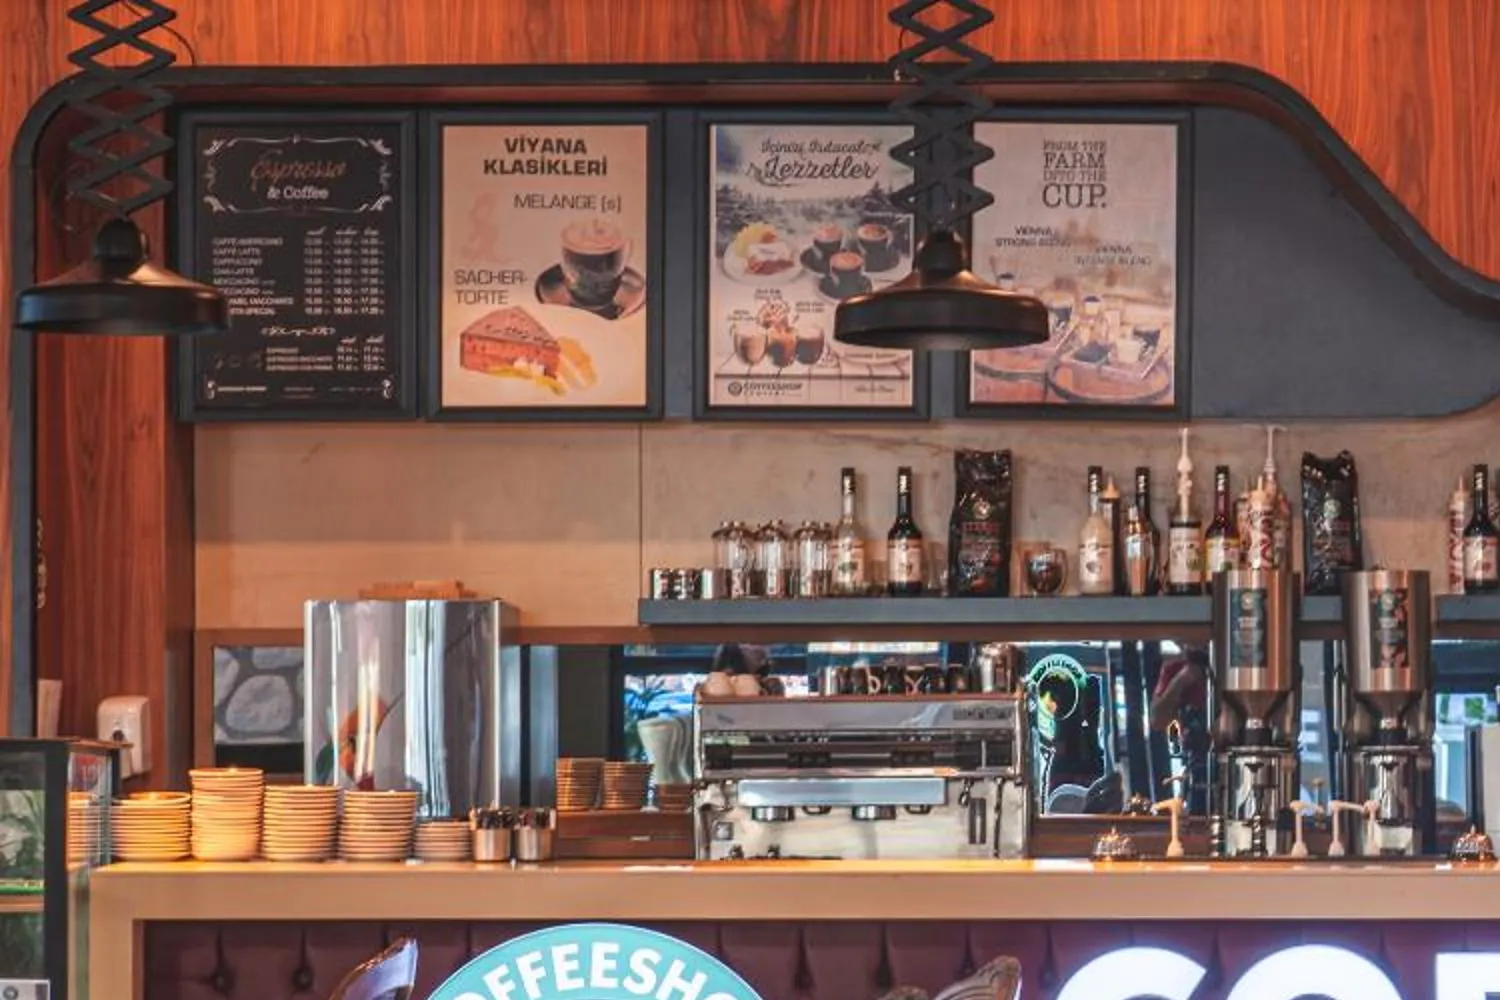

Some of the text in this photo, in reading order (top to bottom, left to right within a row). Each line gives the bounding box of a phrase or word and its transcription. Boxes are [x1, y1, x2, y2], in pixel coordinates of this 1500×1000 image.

[504, 134, 588, 155] VİYANA
[1082, 140, 1107, 151] THE
[484, 156, 608, 176] KLASİKLERİ
[1043, 152, 1107, 169] FARM
[283, 184, 330, 199] Coffee
[1042, 183, 1107, 209] CUP.
[513, 194, 597, 210] MELANGE
[454, 270, 528, 286] SACHER-
[456, 289, 509, 305] TORTE
